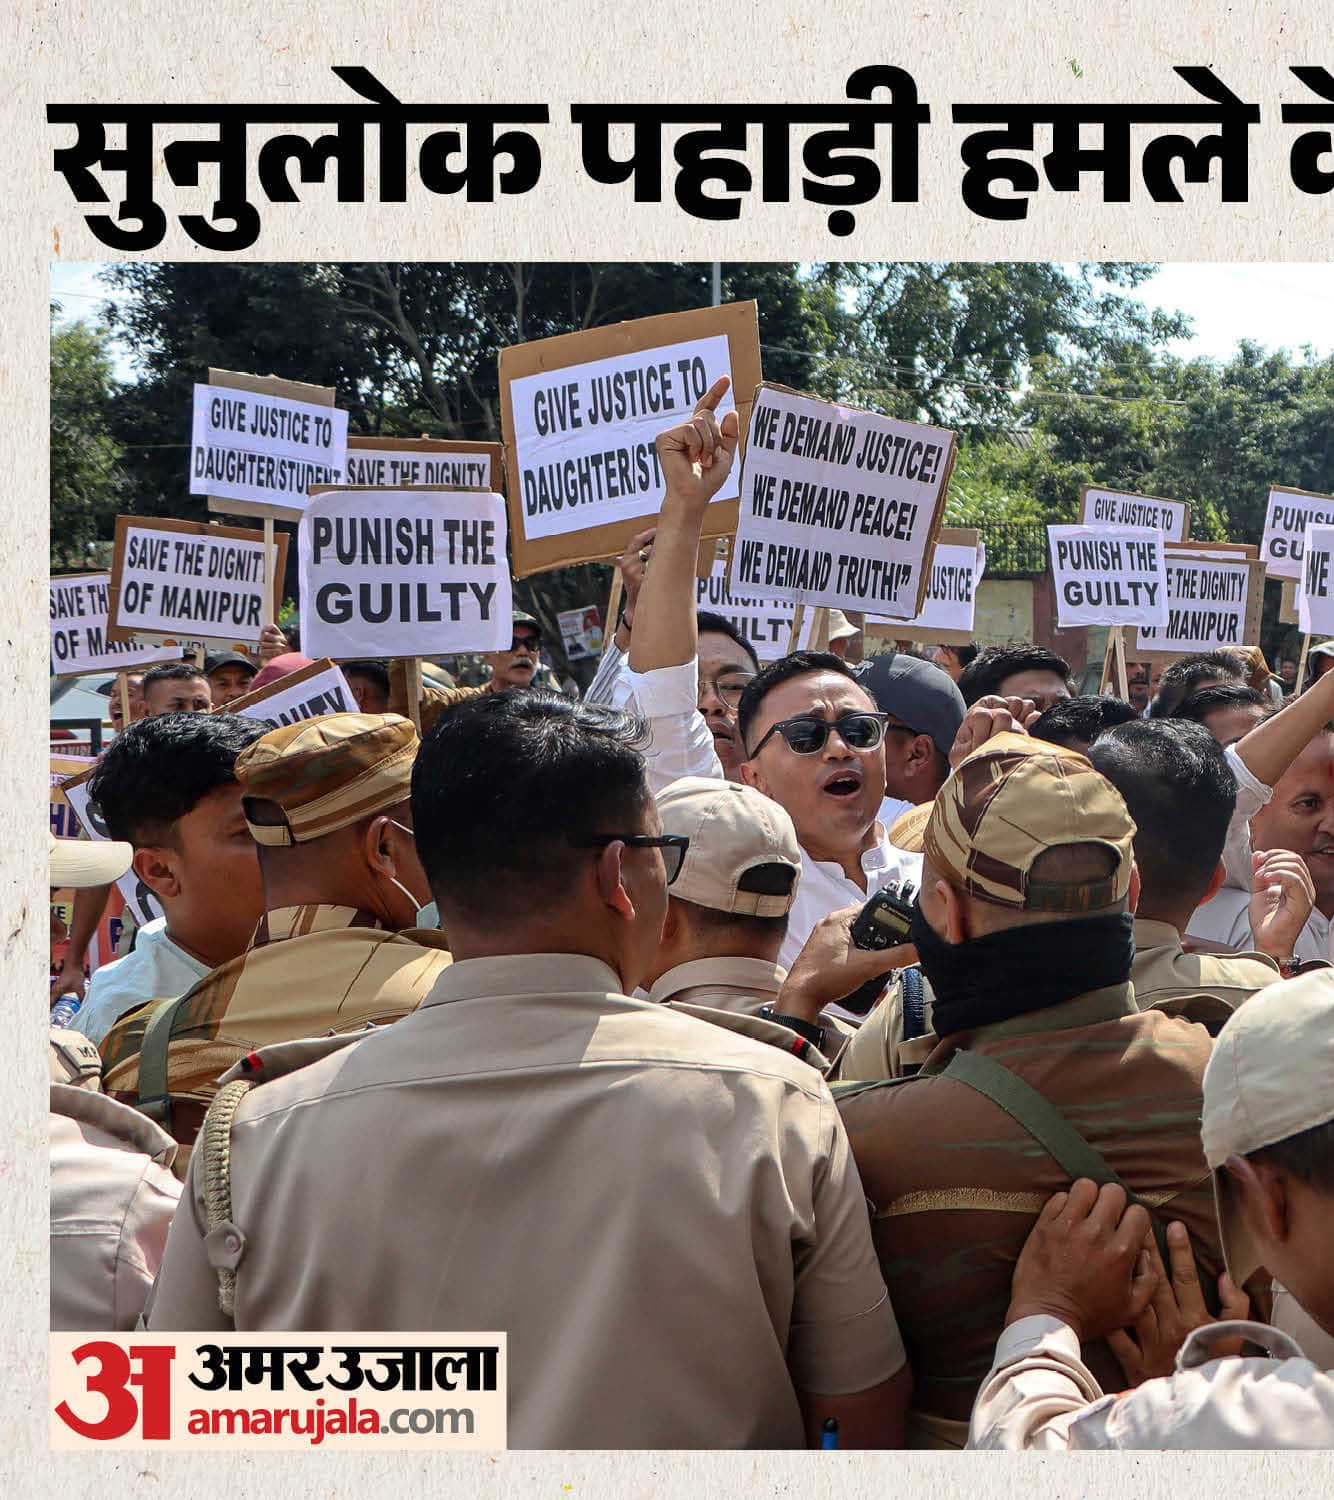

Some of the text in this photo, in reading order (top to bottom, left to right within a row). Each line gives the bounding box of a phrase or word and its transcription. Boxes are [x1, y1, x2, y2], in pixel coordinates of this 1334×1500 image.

[534, 356, 708, 437] GIVE JUSTICE TO
[211, 397, 332, 448] GIVE JUSTICE TO
[753, 405, 943, 484] WE DEMAND JUSTICE!
[194, 446, 342, 495] DAUGHTER/STUDENT
[348, 458, 487, 487] SAVE THE DIGNITY
[523, 442, 662, 517] DAUGHTER/ST
[752, 474, 918, 541] WE DEMAND PEACE!
[1094, 498, 1173, 531] GIVE JUSTICE TO
[128, 535, 170, 572] SAVE
[175, 541, 205, 577] THE
[312, 517, 496, 565] PUNISH THE
[1057, 541, 1158, 572] PUNISH THE
[739, 540, 764, 584] WE
[765, 544, 832, 592] DEMAND
[1176, 568, 1197, 599] THE
[1200, 570, 1245, 602] DIGNITY
[1305, 550, 1330, 597] WE
[124, 581, 262, 626] OF MANIPUR
[315, 582, 497, 624] GUILTY
[1063, 581, 1159, 606] GUILTY
[54, 628, 79, 660] OF
[1166, 610, 1239, 642] MANIPUR
